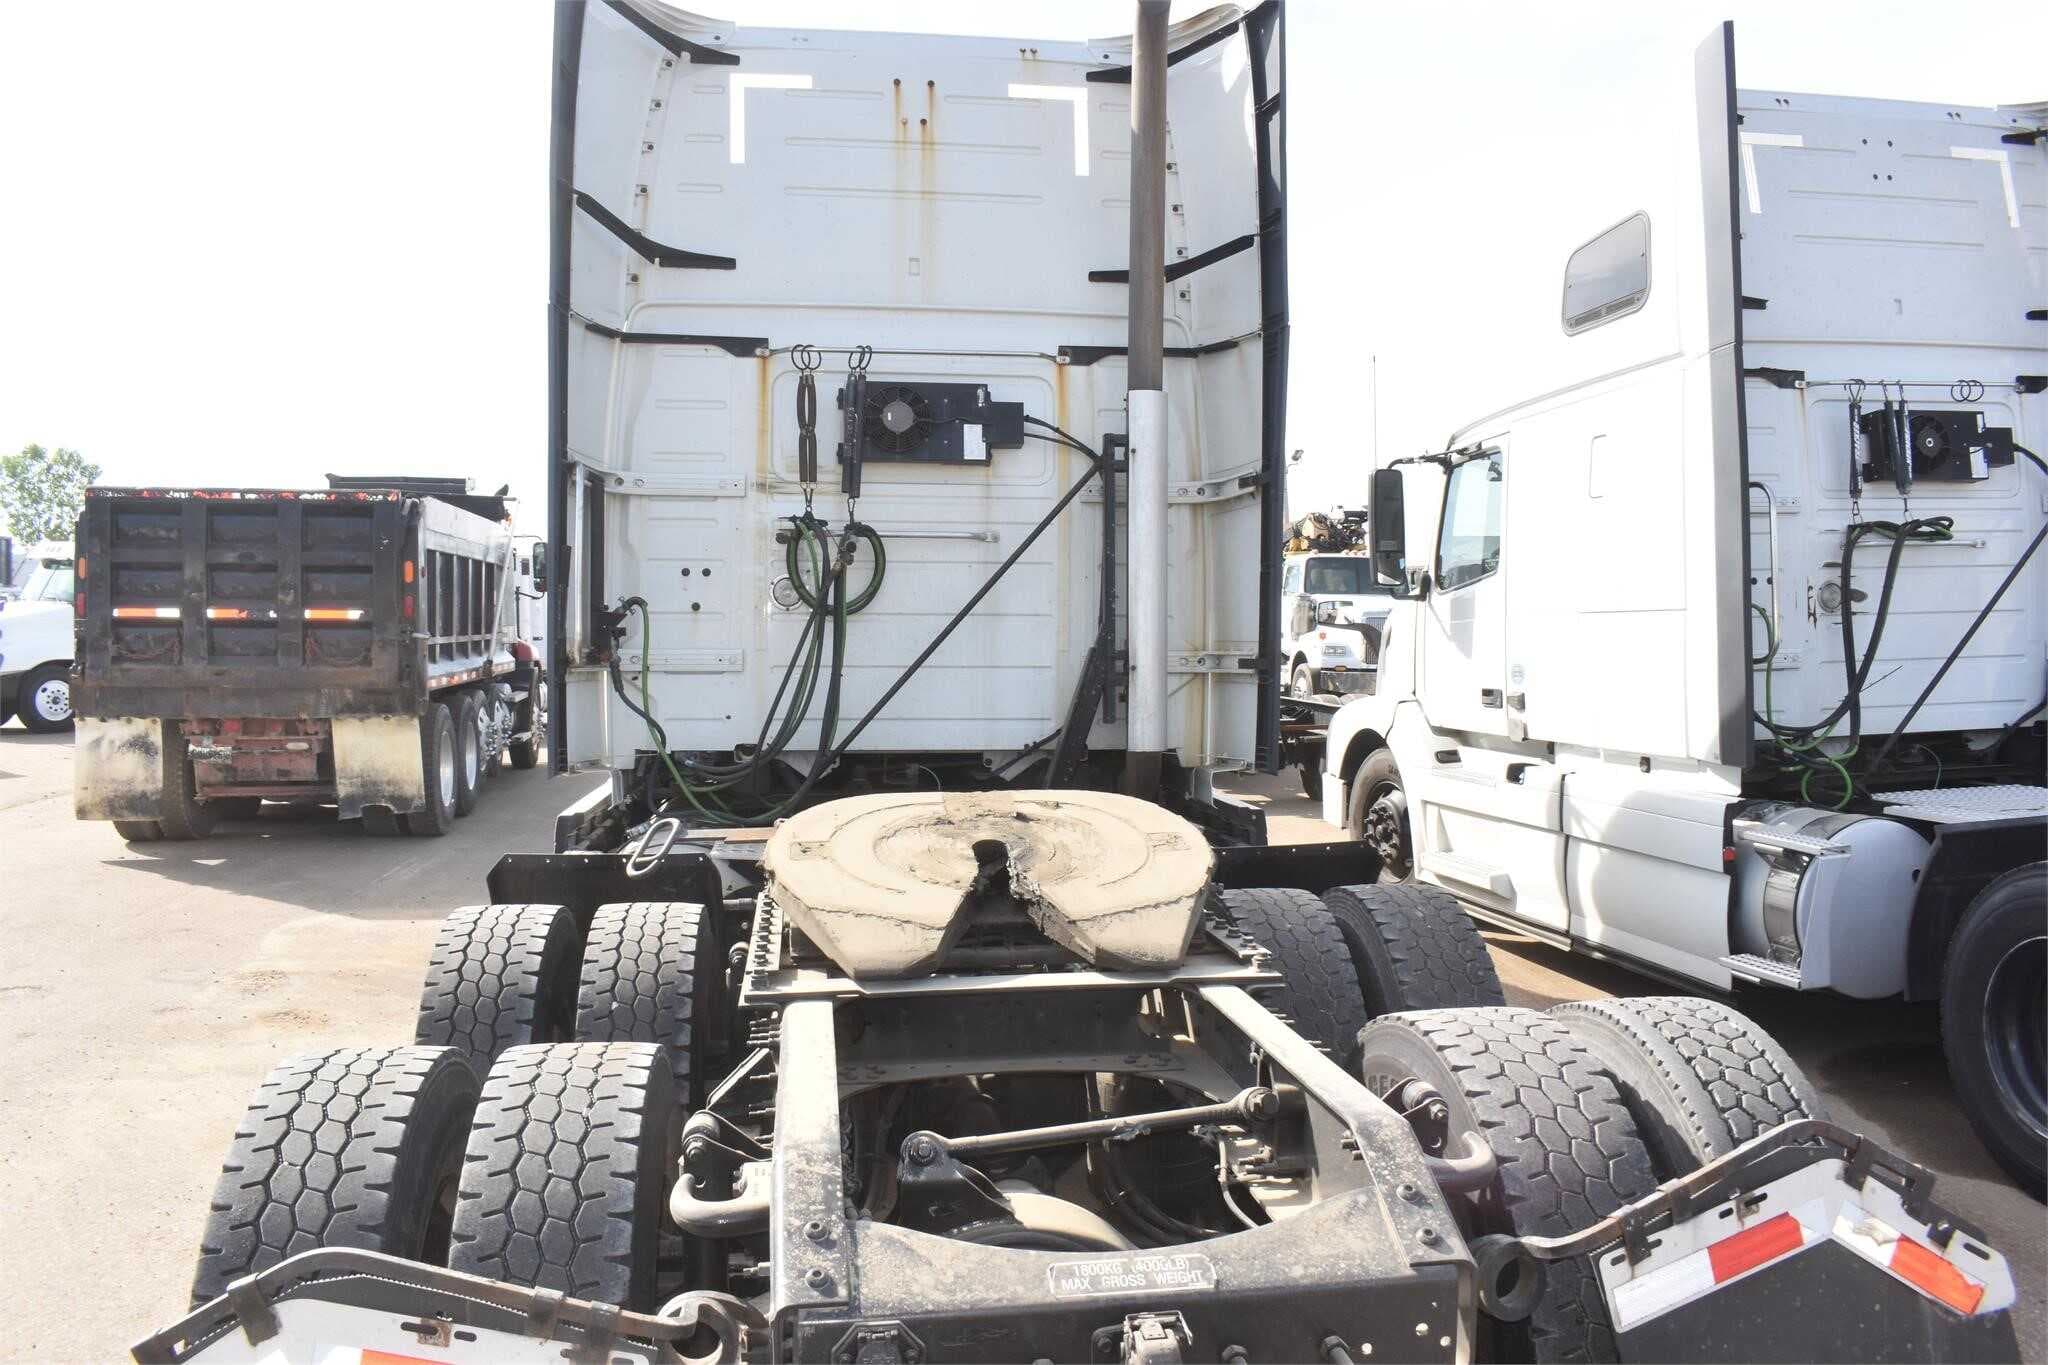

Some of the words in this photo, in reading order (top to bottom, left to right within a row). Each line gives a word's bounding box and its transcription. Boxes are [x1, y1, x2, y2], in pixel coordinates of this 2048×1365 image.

[1073, 1262, 1122, 1277] 1800KG
[1061, 1278, 1092, 1291] MAX
[1102, 1273, 1146, 1288] GROSS
[1153, 1269, 1203, 1285] WEIGHT
